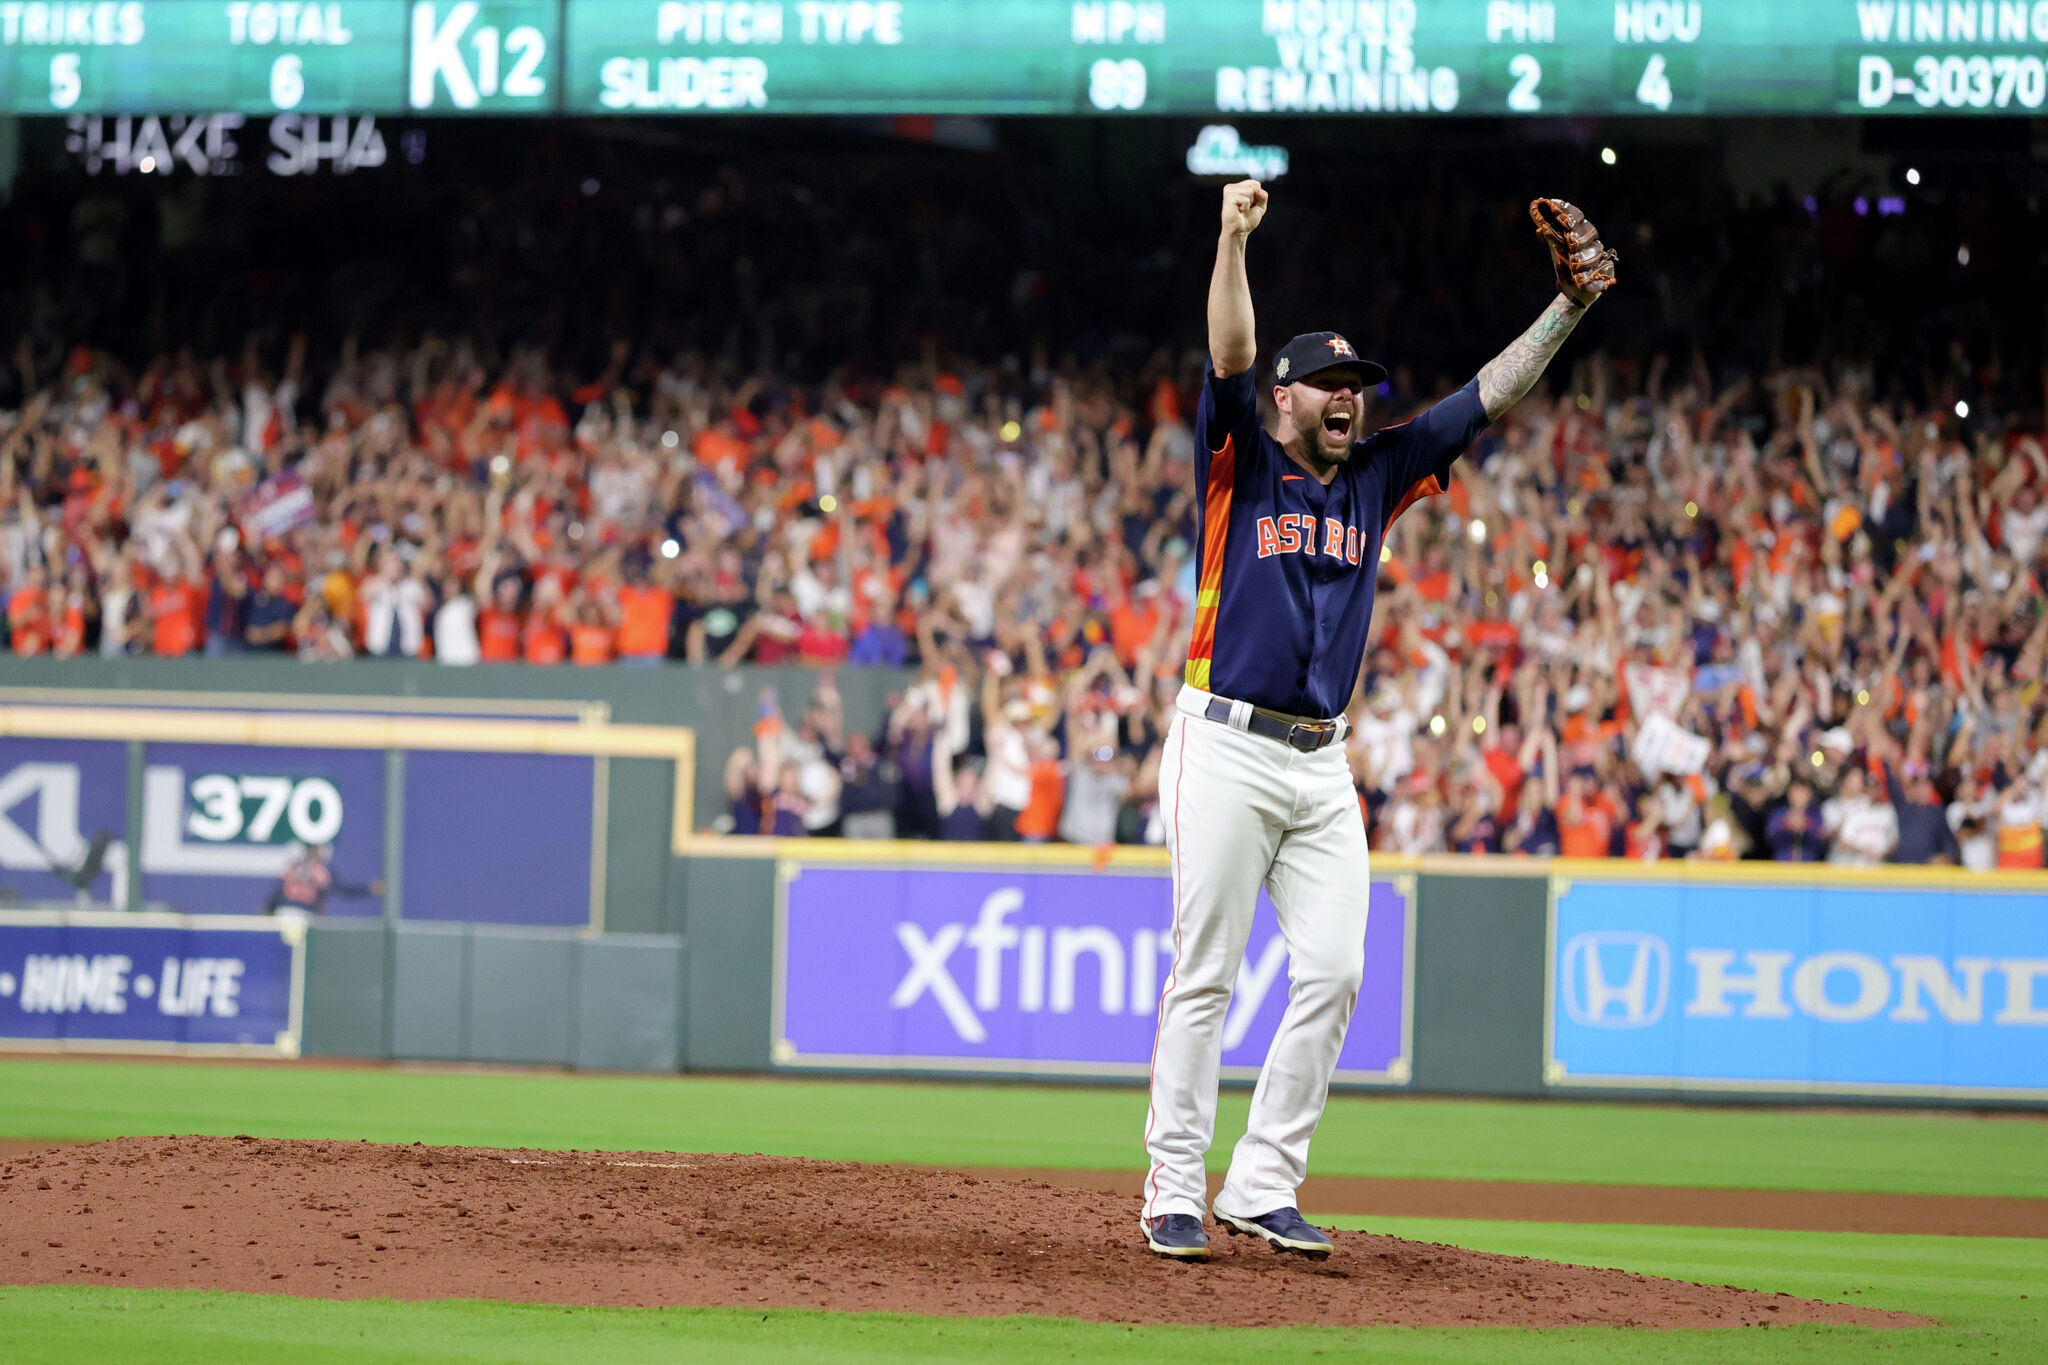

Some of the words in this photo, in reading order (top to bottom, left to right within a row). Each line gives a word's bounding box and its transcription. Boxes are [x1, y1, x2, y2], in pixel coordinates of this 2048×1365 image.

[227, 1, 352, 45] TOTAL
[657, 0, 784, 44] PITCH
[796, 0, 903, 44] TYPE
[1071, 1, 1167, 44] MPH
[1261, 0, 1418, 36] MOUND
[1486, 1, 1556, 43] PHI
[1613, 1, 1702, 43] HOU
[1275, 31, 1415, 74] VISITS
[50, 52, 82, 109] 5
[270, 53, 304, 109] 6
[599, 56, 768, 109] SLIDER
[1216, 66, 1459, 112] REMAINING
[1507, 53, 1542, 110] 2
[1635, 53, 1672, 111] 4
[1256, 513, 1367, 568] ASTRO
[187, 773, 345, 844] 370
[20, 953, 133, 1014] HOME
[158, 956, 246, 1018] LIFE
